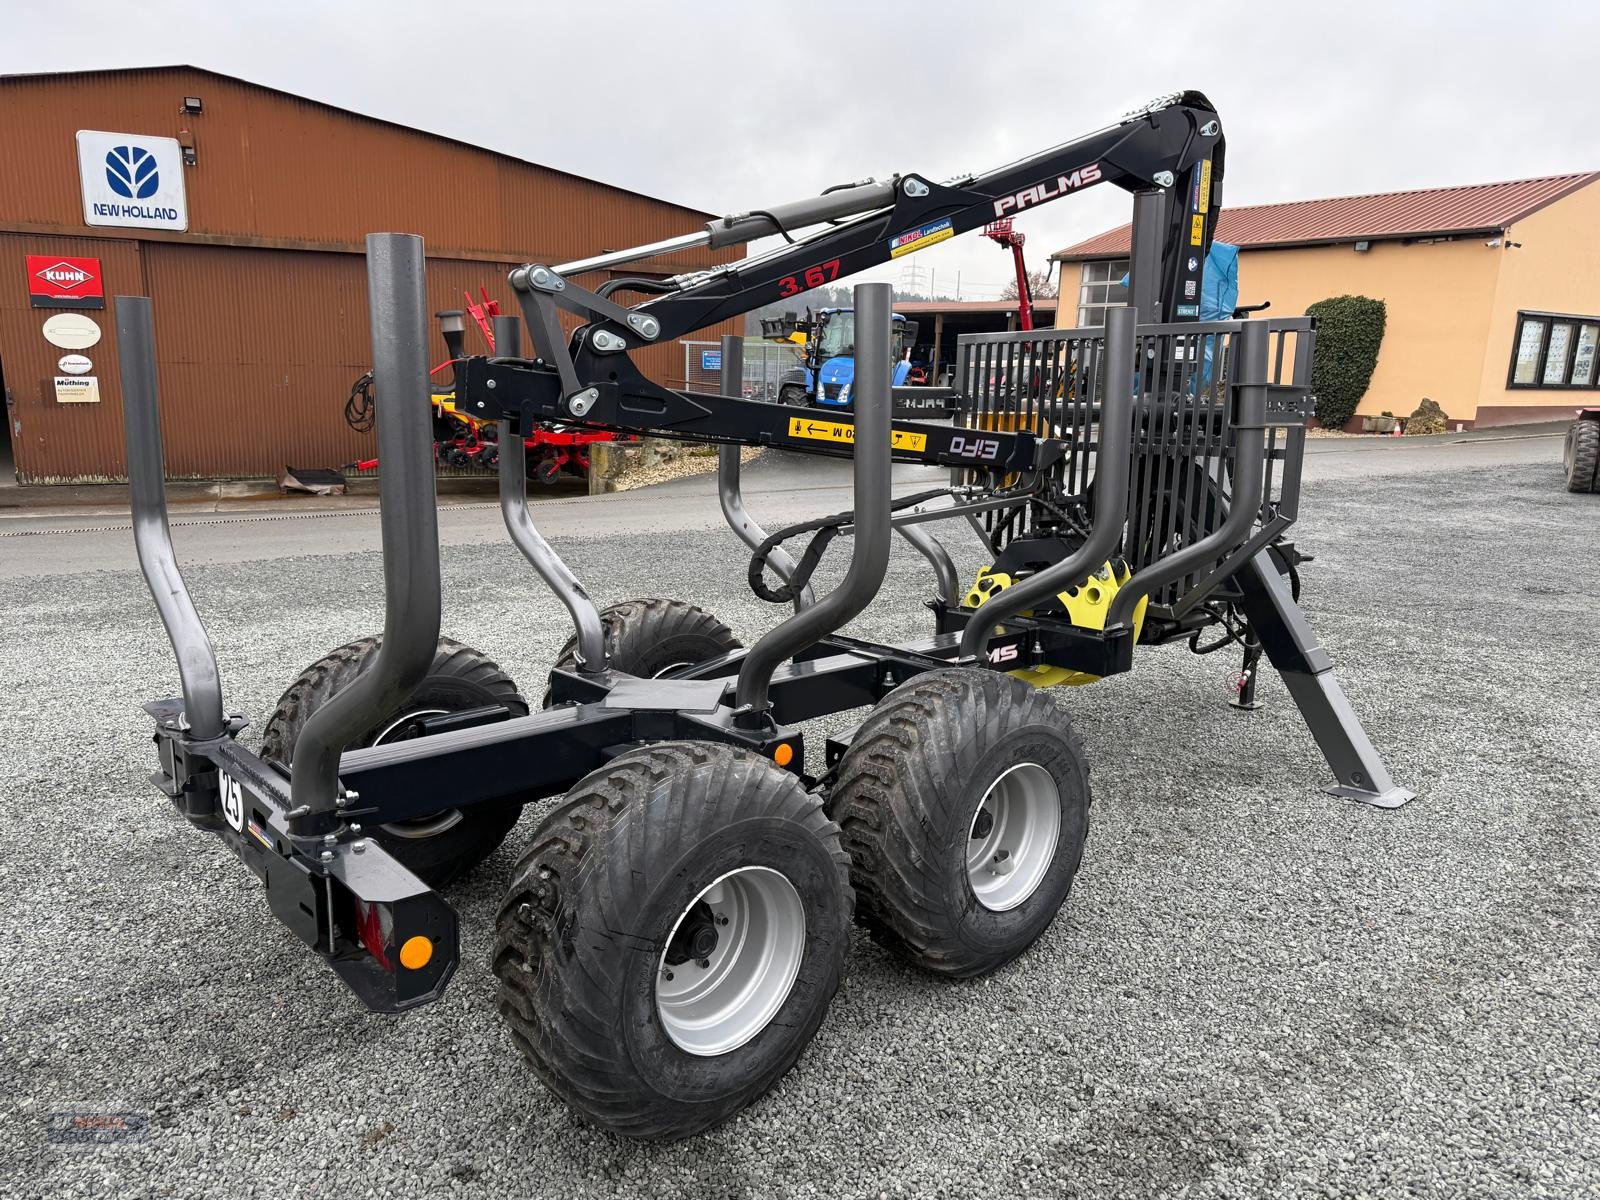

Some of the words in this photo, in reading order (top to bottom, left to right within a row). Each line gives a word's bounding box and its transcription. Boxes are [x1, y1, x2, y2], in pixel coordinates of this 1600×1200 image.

[993, 163, 1102, 218] PALMS
[93, 203, 120, 217] NEW
[122, 205, 178, 220] HOLLAND
[899, 229, 923, 246] NIKOL
[45, 271, 85, 281] KUHN
[777, 259, 841, 298] 3.67
[832, 427, 843, 438] M
[222, 772, 239, 823] 25
